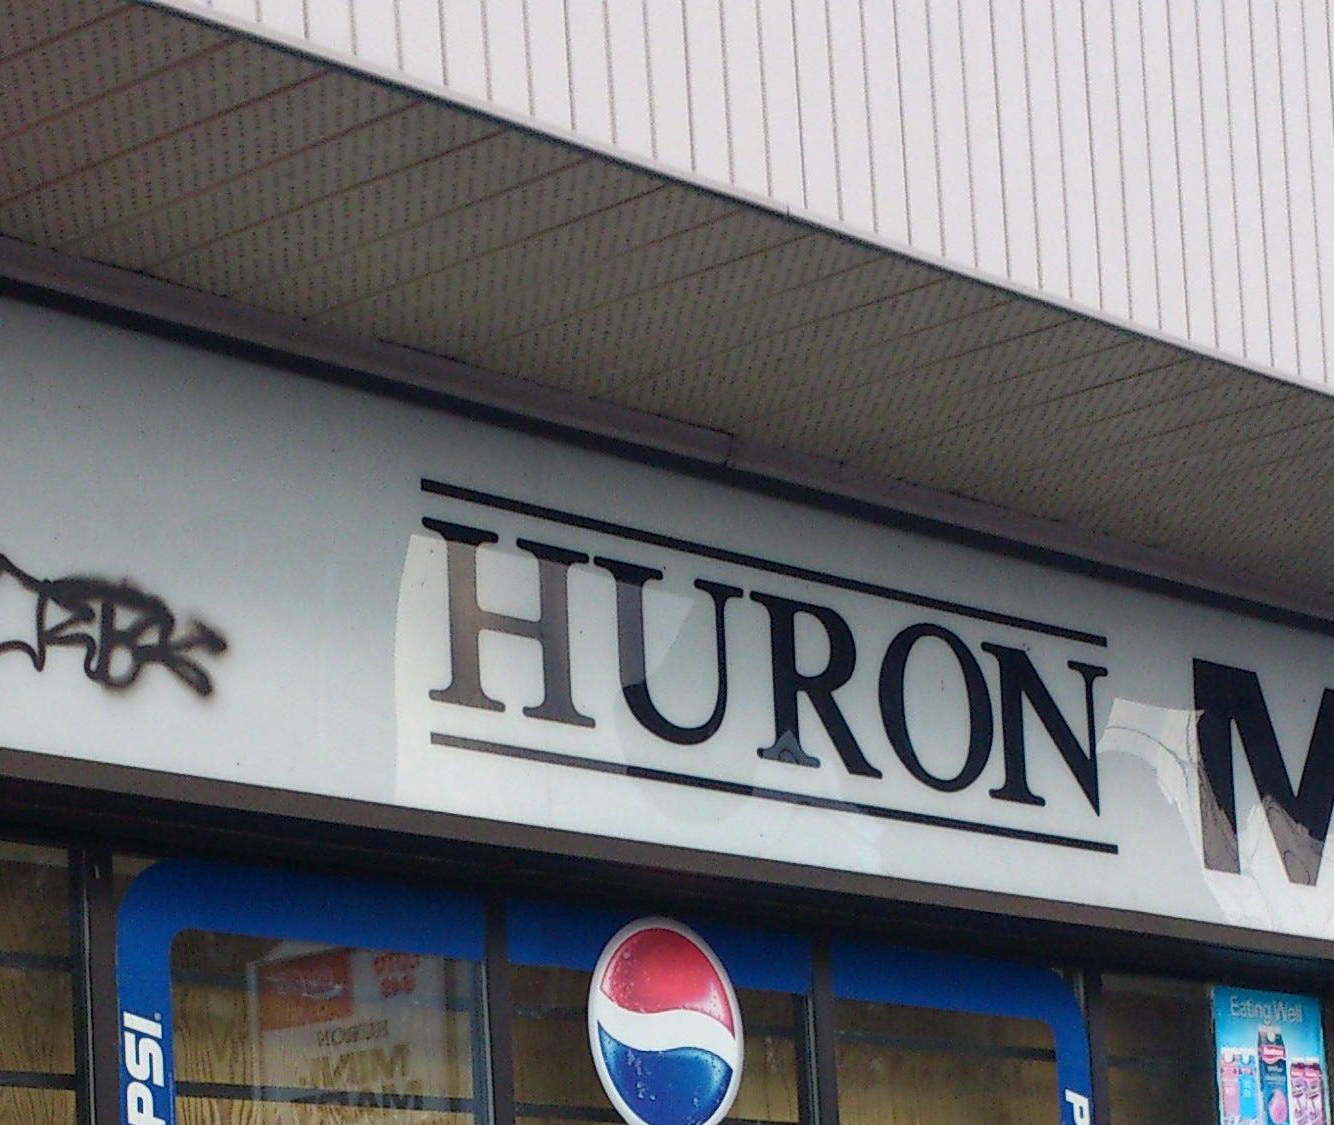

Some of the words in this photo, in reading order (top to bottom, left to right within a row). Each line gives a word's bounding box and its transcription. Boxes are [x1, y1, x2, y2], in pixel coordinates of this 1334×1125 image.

[421, 516, 1109, 818] HURON
[1230, 996, 1273, 1023] Eating
[1271, 1000, 1303, 1023] Well
